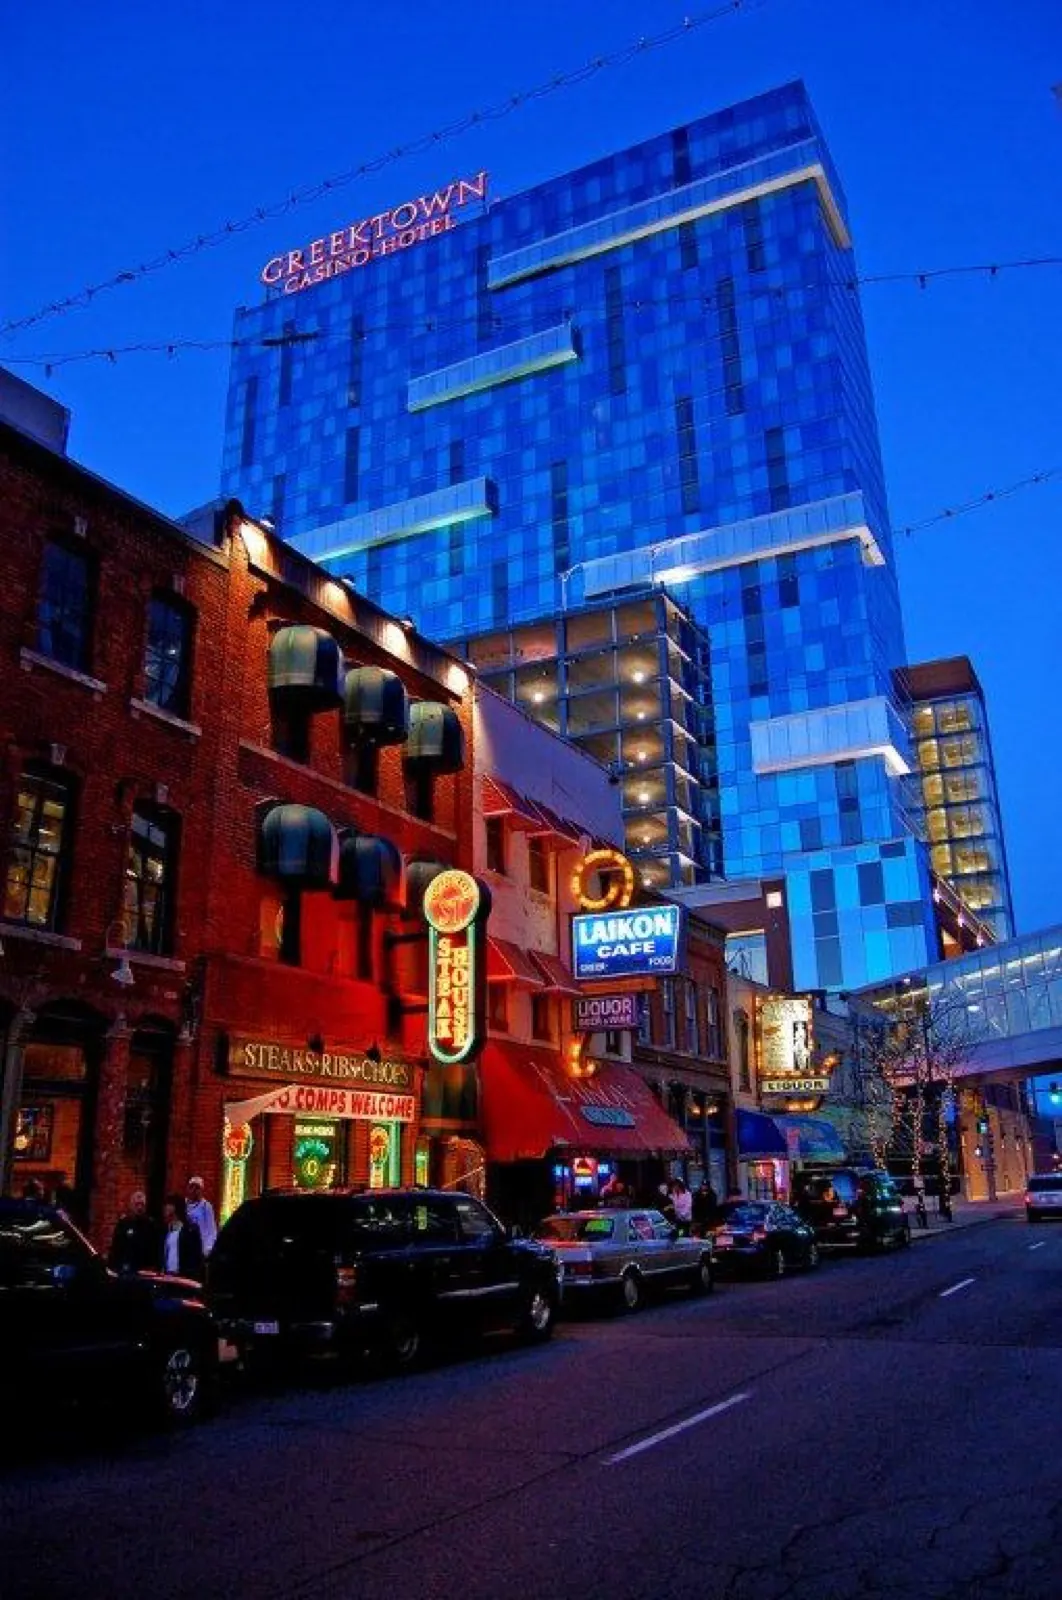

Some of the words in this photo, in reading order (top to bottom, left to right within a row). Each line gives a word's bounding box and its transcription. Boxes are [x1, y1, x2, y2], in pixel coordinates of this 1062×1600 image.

[262, 170, 488, 283] GREEKTOWN
[578, 911, 673, 946] LAIKON
[596, 941, 656, 958] CAFE
[436, 937, 453, 1038] STEAK
[452, 947, 470, 1047] HOUSE
[244, 1043, 314, 1074] STEAKS
[768, 1080, 824, 1091] LIQUOR
[295, 1087, 346, 1114] COMPS
[351, 1093, 413, 1118] WELCOME
